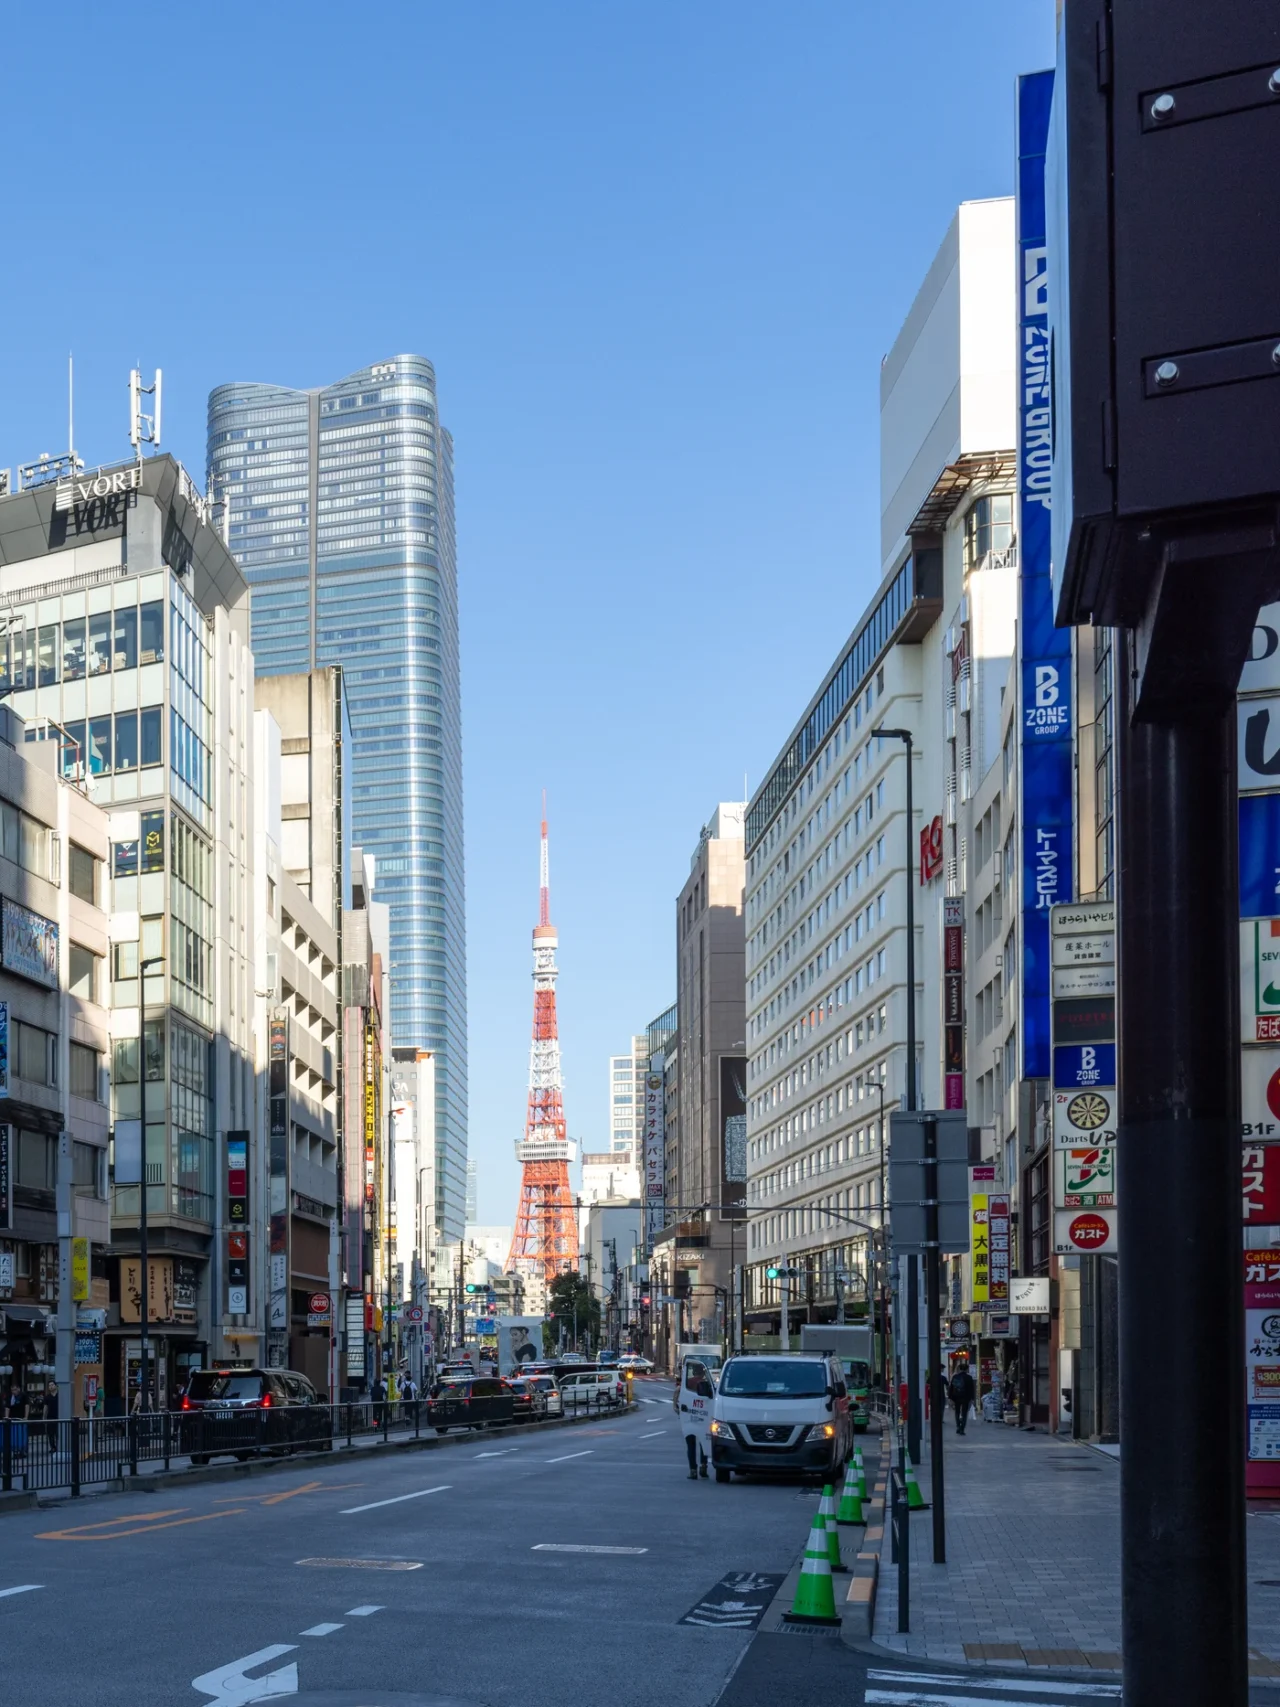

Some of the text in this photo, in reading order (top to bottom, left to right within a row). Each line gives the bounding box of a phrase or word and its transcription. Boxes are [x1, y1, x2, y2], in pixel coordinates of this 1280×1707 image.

[78, 467, 141, 501] VORT
[1026, 706, 1068, 727] ZONE
[1034, 725, 1060, 735] GROUP
[945, 907, 961, 917] TK
[1058, 912, 1114, 925] ほうらいやビル
[1082, 1047, 1096, 1070] B
[1076, 1069, 1101, 1081] ZONE
[1057, 1095, 1068, 1103] 2F
[647, 1093, 657, 1140] カラオケ
[1241, 1122, 1275, 1136] B1F
[1060, 1130, 1118, 1146] Darts UP
[647, 1147, 658, 1181] パセラ
[1065, 1196, 1081, 1206] たばこ
[1097, 1195, 1113, 1205] ATM
[1075, 1229, 1105, 1240] ガスト
[991, 1217, 1008, 1282] 査定無料
[1057, 1244, 1073, 1252] B1F
[973, 1235, 988, 1286] 大黒屋
[693, 1400, 704, 1408] NTS
